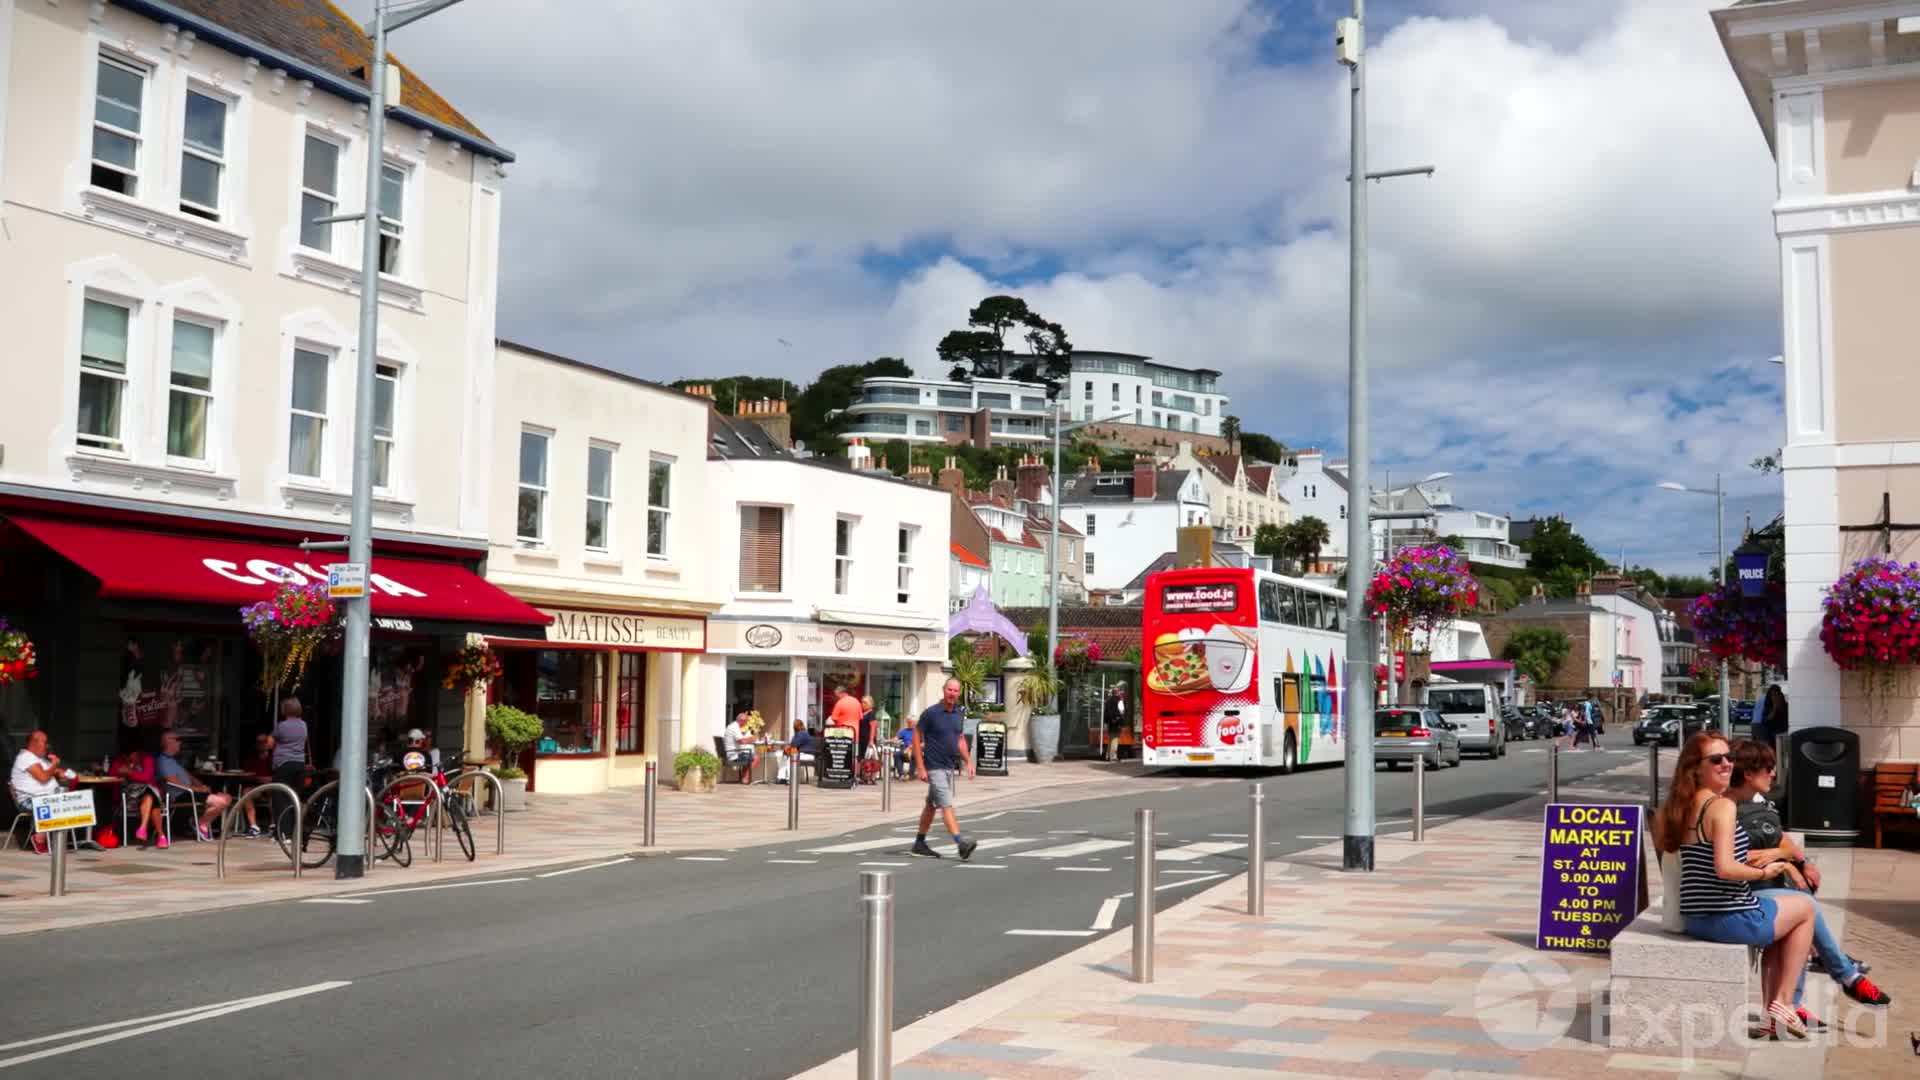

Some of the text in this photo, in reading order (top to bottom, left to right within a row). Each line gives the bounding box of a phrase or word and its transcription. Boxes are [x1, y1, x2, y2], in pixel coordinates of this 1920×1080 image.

[202, 558, 428, 597] COA
[1738, 568, 1764, 580] POLICE
[1166, 589, 1234, 600] www.food.je
[557, 612, 691, 644] MATISSE BEAUTY
[1217, 725, 1243, 737] food
[1559, 808, 1626, 824] LOCAL
[1550, 829, 1634, 846] MARKET
[1580, 848, 1600, 858] AT
[1553, 860, 1626, 871] ST. AUBIN
[1560, 873, 1617, 884] 9.00 AM
[1578, 886, 1599, 896] TO
[1559, 899, 1616, 910] 4.00 PM
[1551, 911, 1622, 923] TUESDAY
[1580, 925, 1592, 935] &
